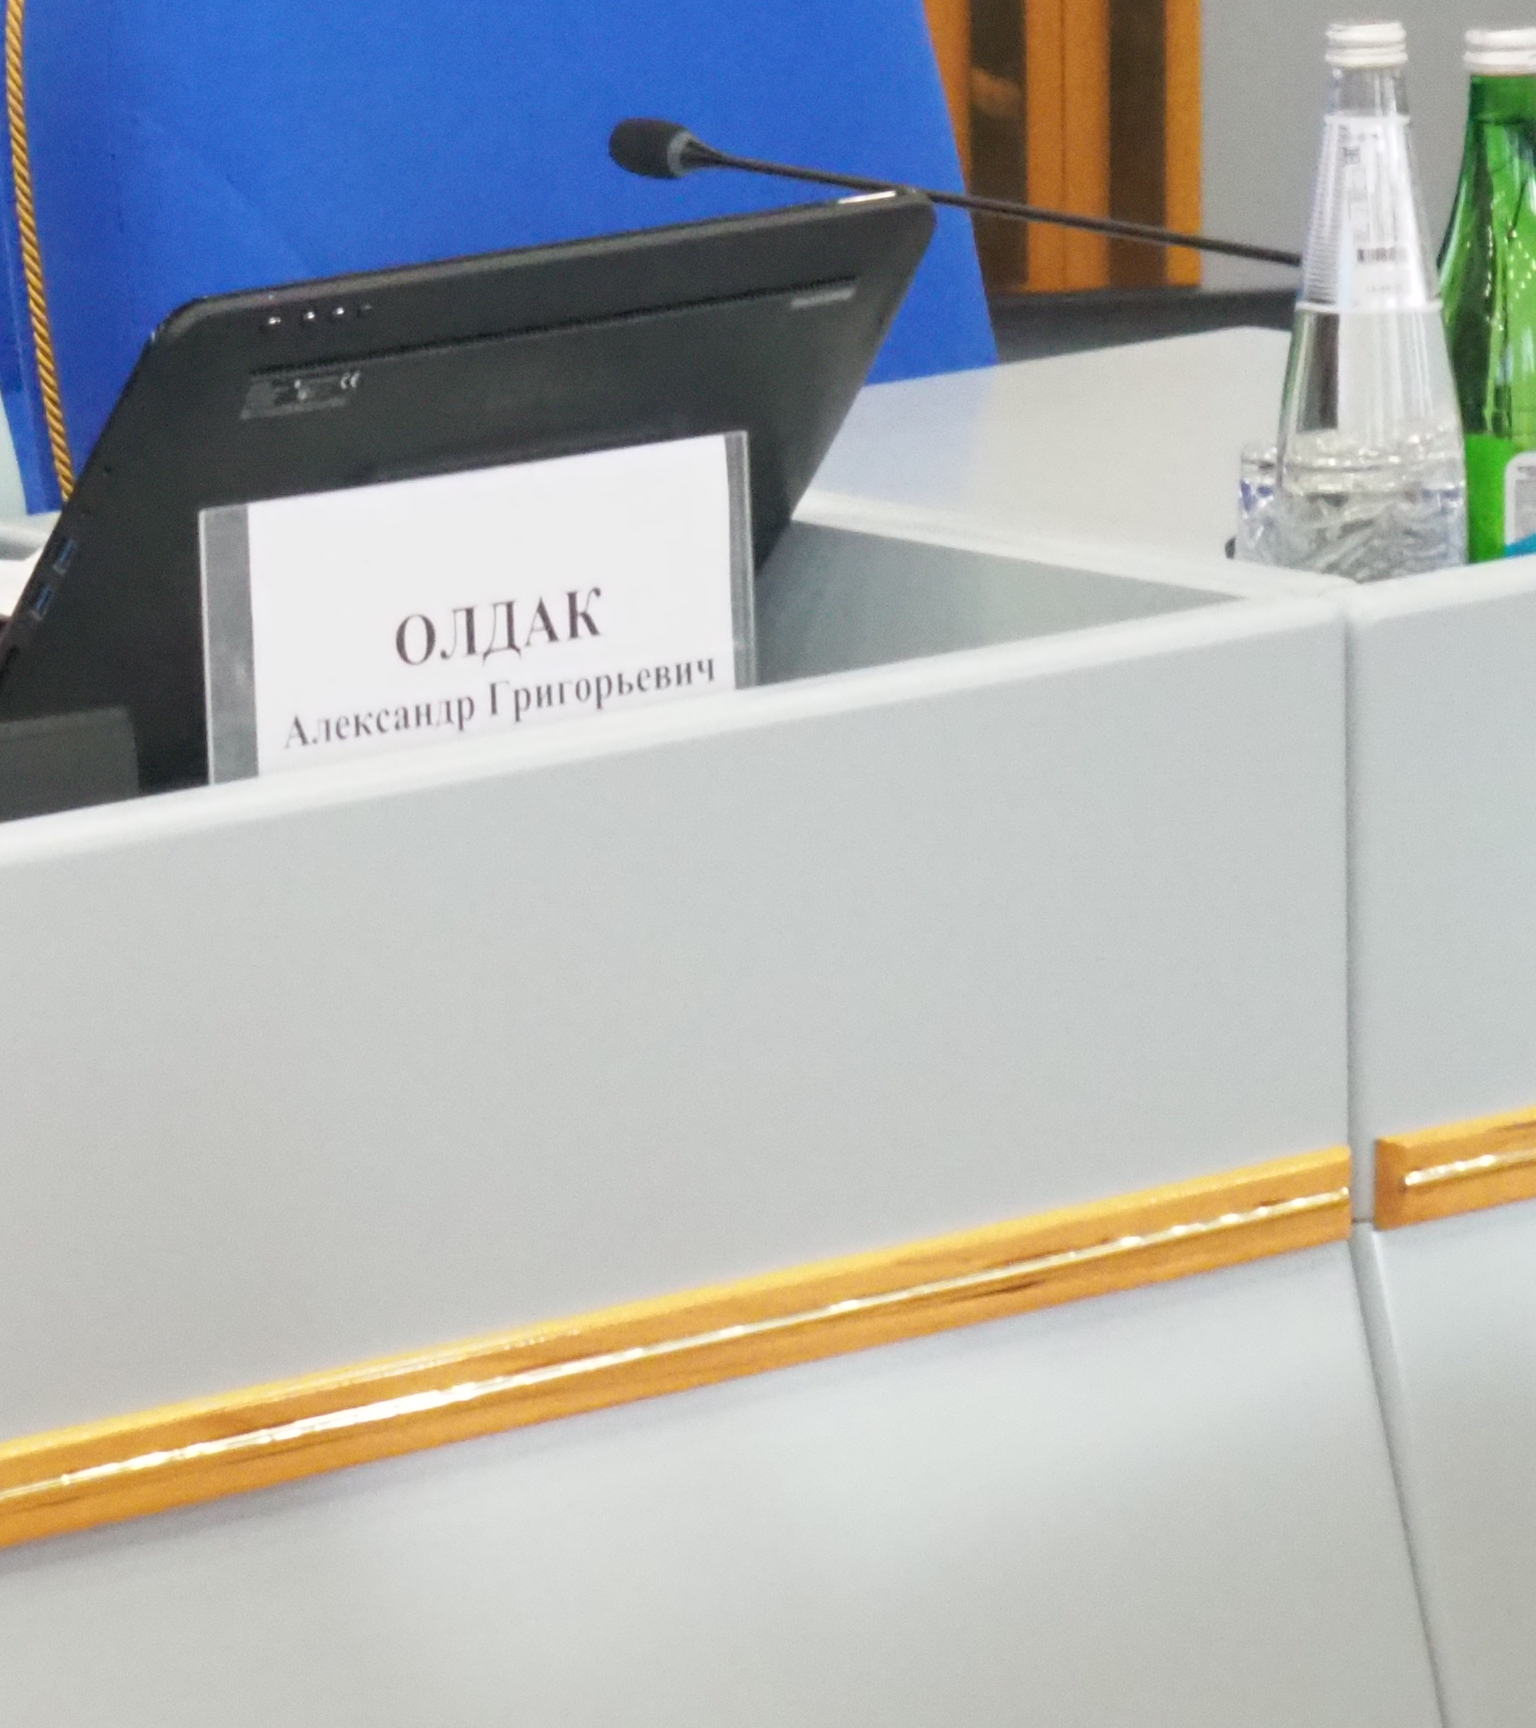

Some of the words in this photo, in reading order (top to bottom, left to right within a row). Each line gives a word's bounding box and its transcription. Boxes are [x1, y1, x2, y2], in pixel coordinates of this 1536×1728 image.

[394, 585, 603, 666] ОЛДАК
[284, 695, 476, 749] Александр
[488, 655, 716, 723] Григорьевич
